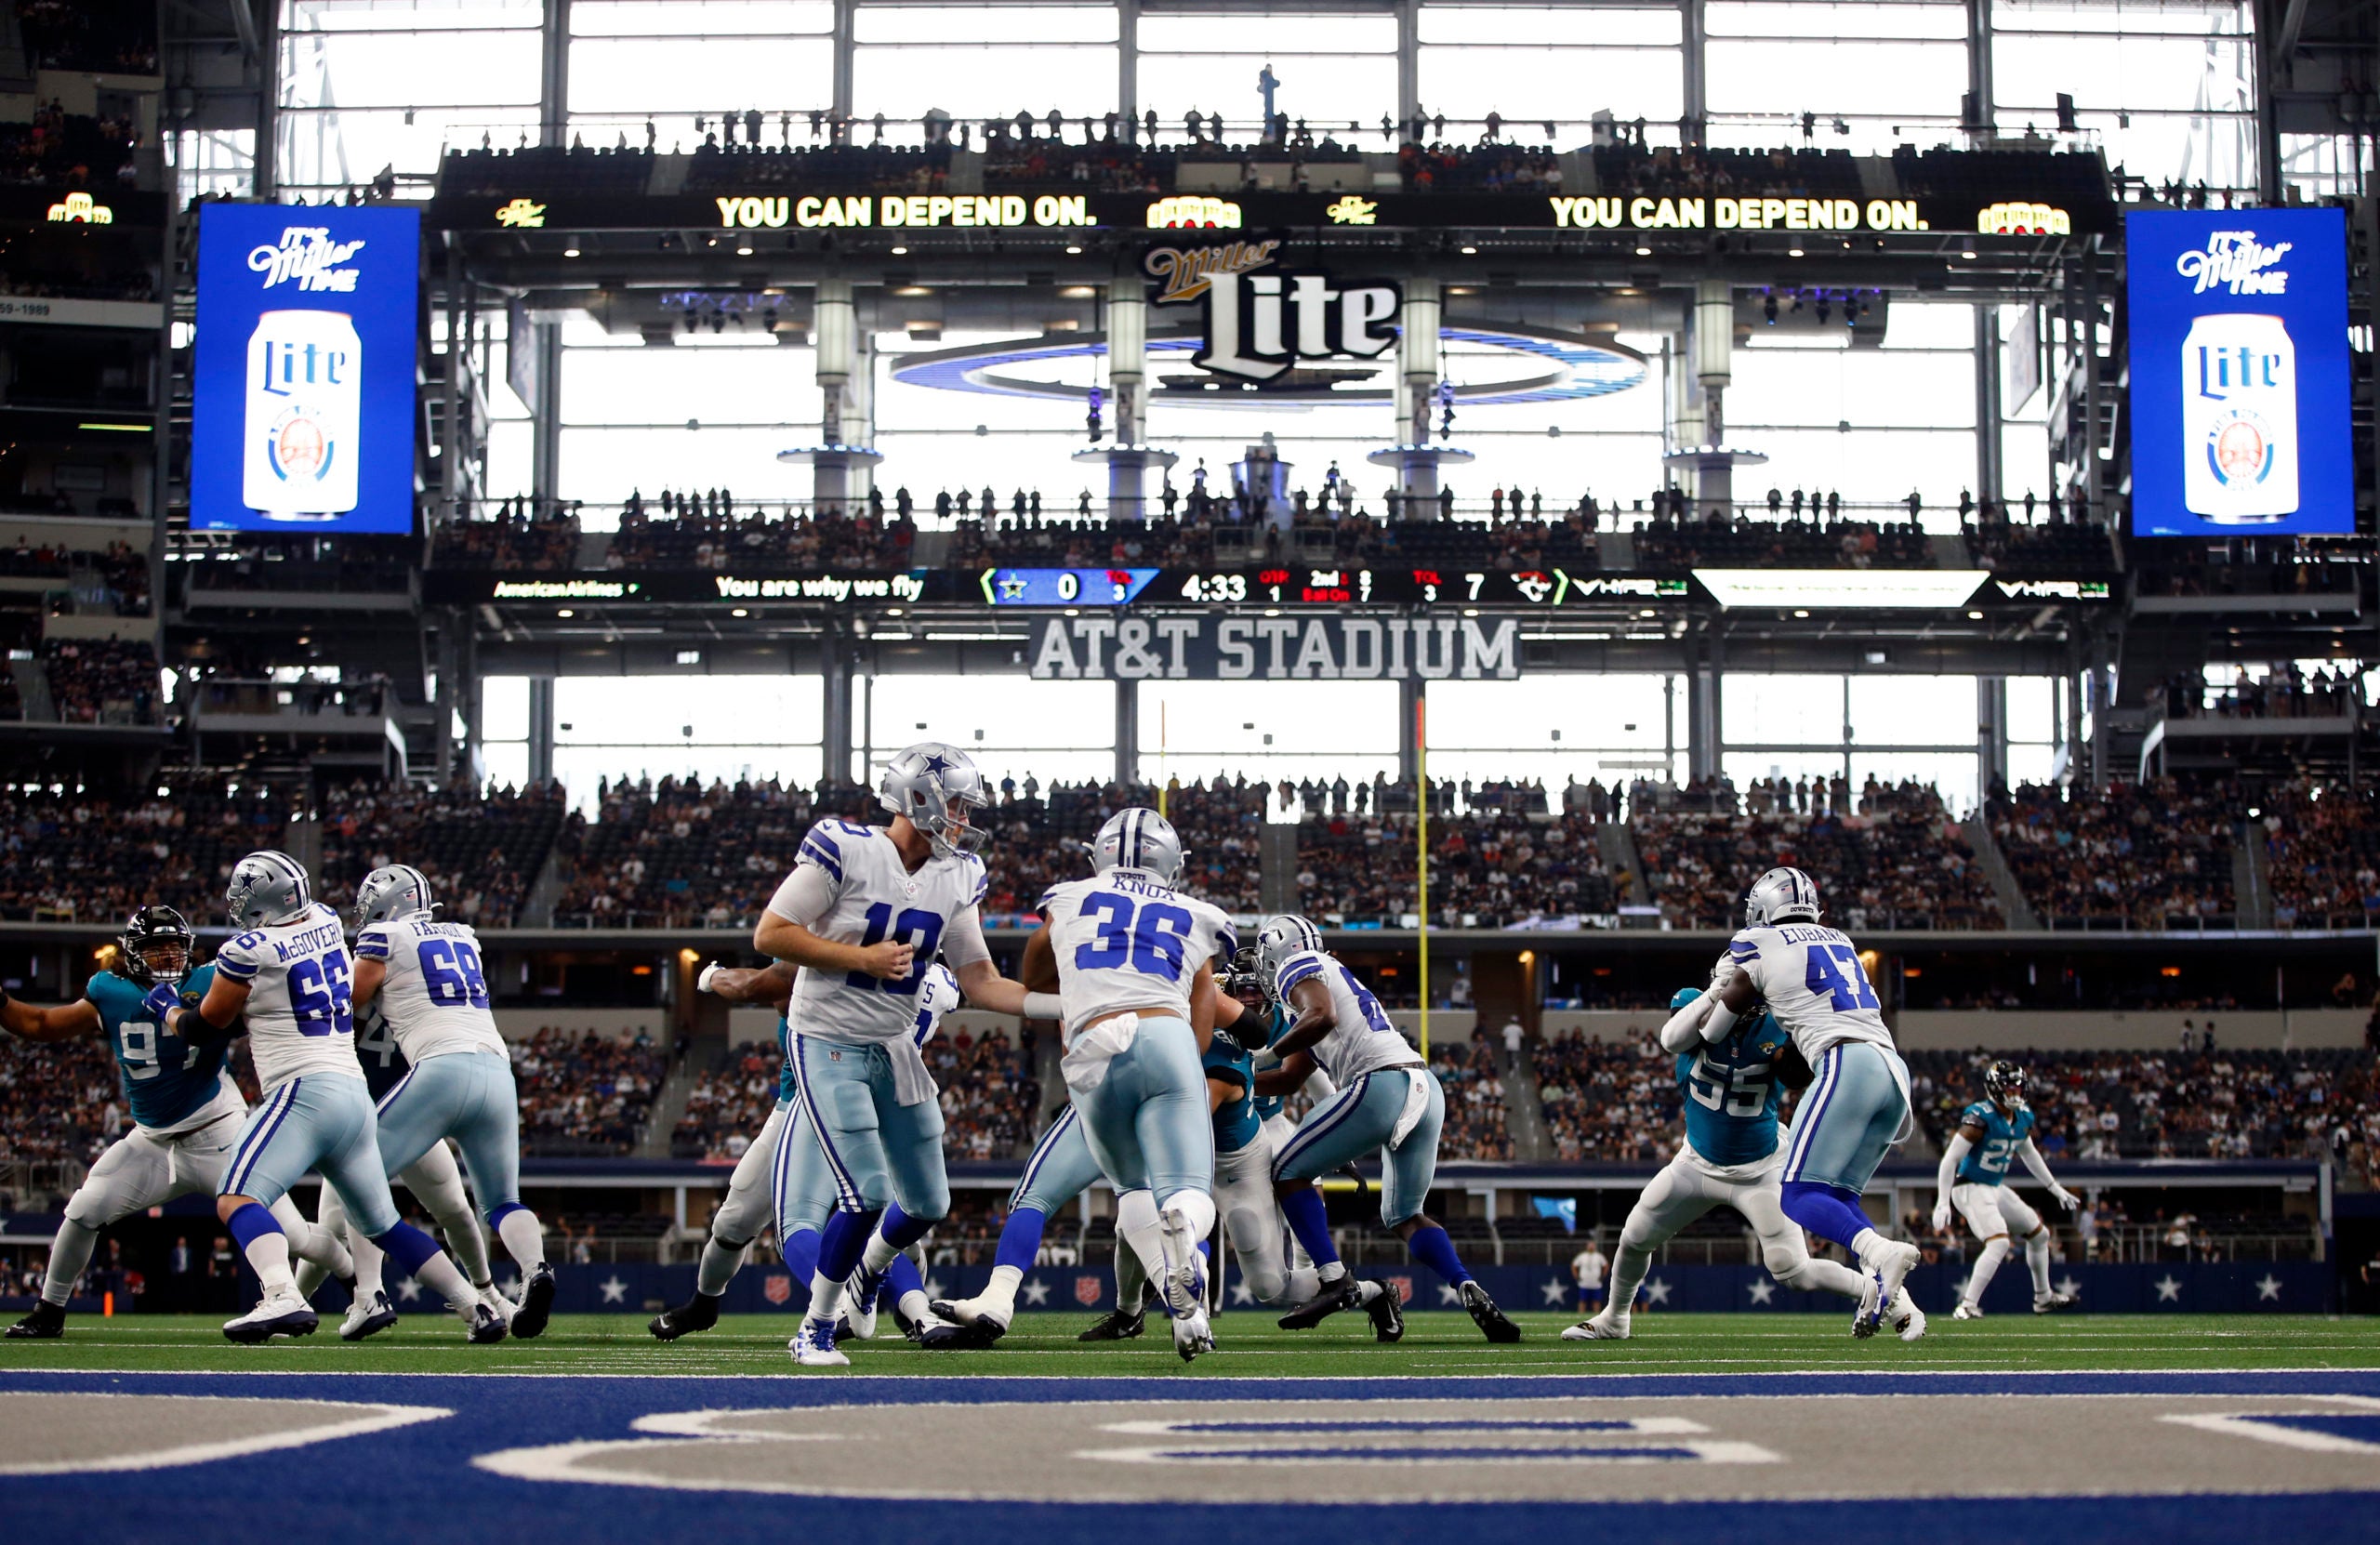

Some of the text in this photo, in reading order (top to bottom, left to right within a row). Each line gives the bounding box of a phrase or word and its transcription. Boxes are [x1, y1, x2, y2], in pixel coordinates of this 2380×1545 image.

[715, 195, 1098, 228] YOU CAN DEPEND ON.
[1549, 197, 1929, 231] YOU CAN DEPEND ON.
[246, 240, 366, 290] Miller
[298, 268, 361, 292] TIME
[1144, 238, 1281, 299] Miller
[2175, 242, 2294, 296] Miller
[2228, 271, 2290, 296] TIME
[1198, 272, 1396, 380] Lite
[262, 340, 346, 397] Lite
[2197, 345, 2281, 401] Lite
[493, 580, 567, 598] American
[715, 574, 925, 602] You are why we fly
[1057, 573, 1078, 601] 0
[1112, 584, 1126, 601] 3
[1181, 574, 1247, 602] 4:33
[1268, 585, 1281, 602] 1
[1310, 569, 1339, 587] 2nd
[1358, 569, 1372, 587] 8
[1412, 570, 1443, 585] TOL
[1423, 584, 1437, 602] 3
[1464, 573, 1486, 601] 7
[1358, 586, 1372, 603] 7
[1031, 618, 1519, 680] AT&T STADIUM
[271, 920, 343, 963] McGOVERN
[1074, 891, 1194, 983] 36
[416, 938, 491, 1010] 68
[1805, 944, 1881, 1013] 47
[286, 947, 354, 1037] 66
[1689, 1047, 1771, 1117] 55
